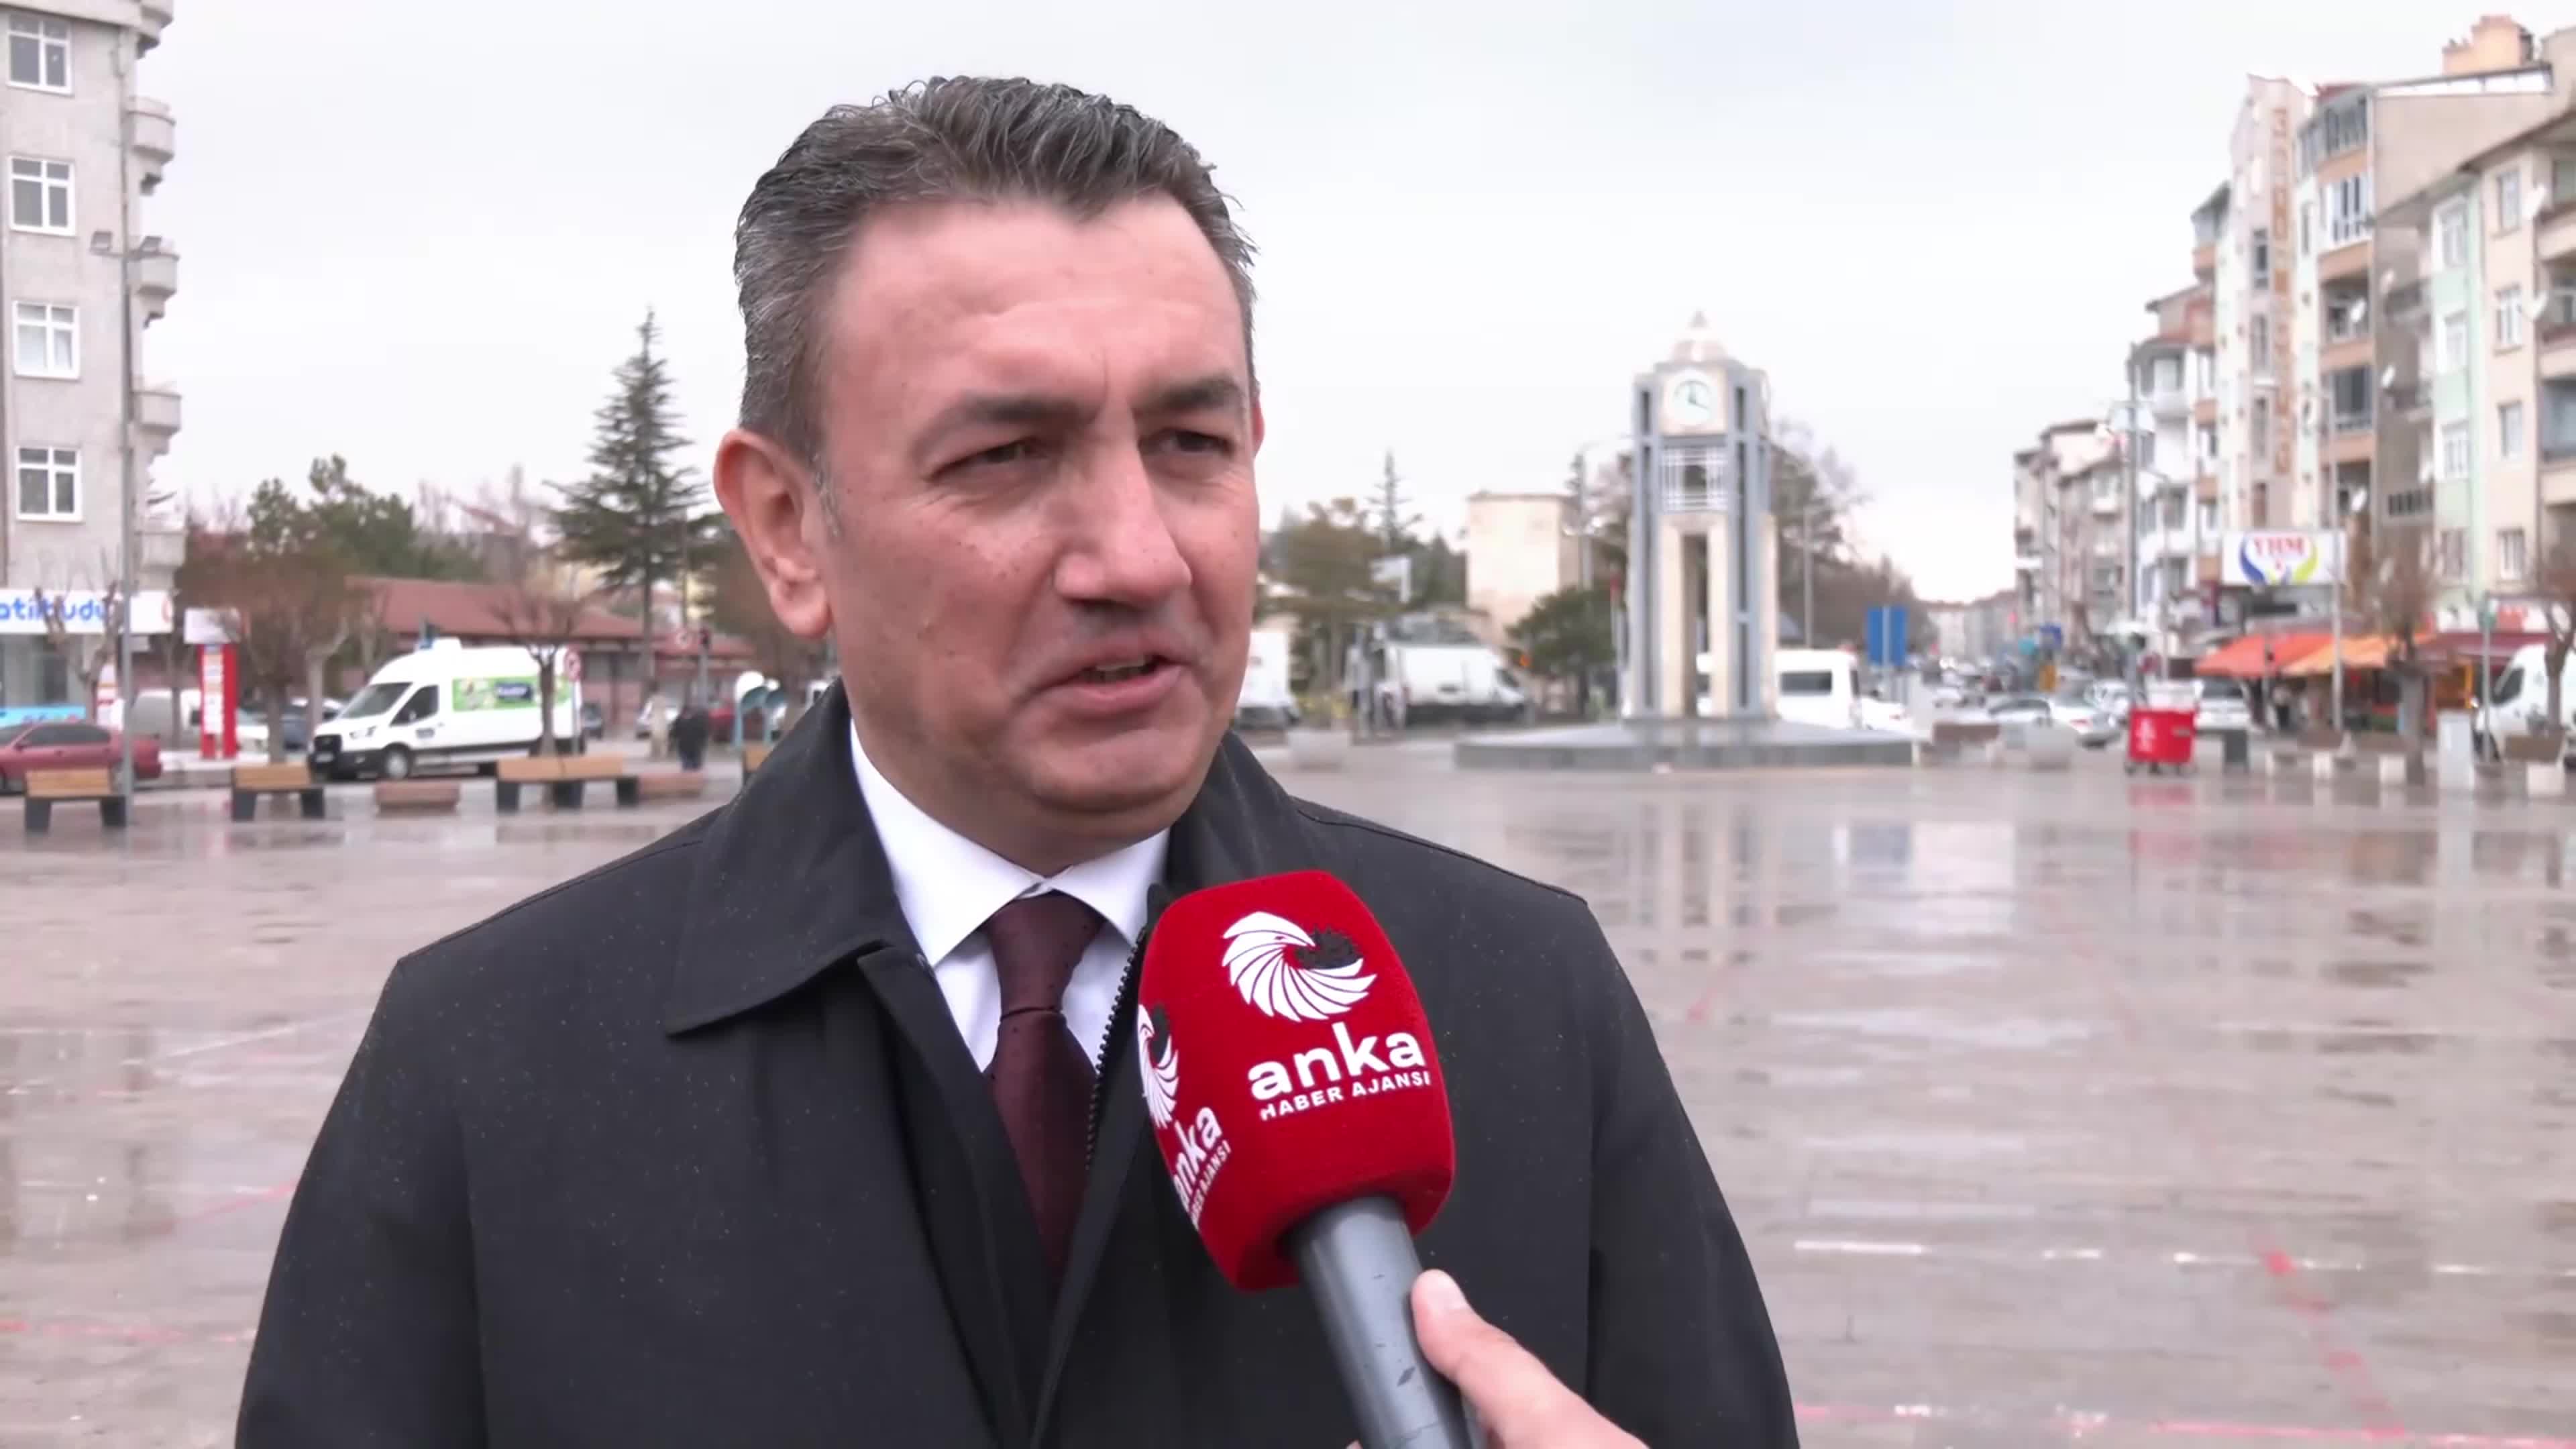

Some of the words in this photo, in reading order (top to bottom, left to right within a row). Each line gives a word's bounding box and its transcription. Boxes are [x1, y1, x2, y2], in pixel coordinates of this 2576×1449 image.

[1248, 1021, 1426, 1101] anka
[1259, 1086, 1344, 1121] HABER
[1352, 1071, 1431, 1097] AJANSI
